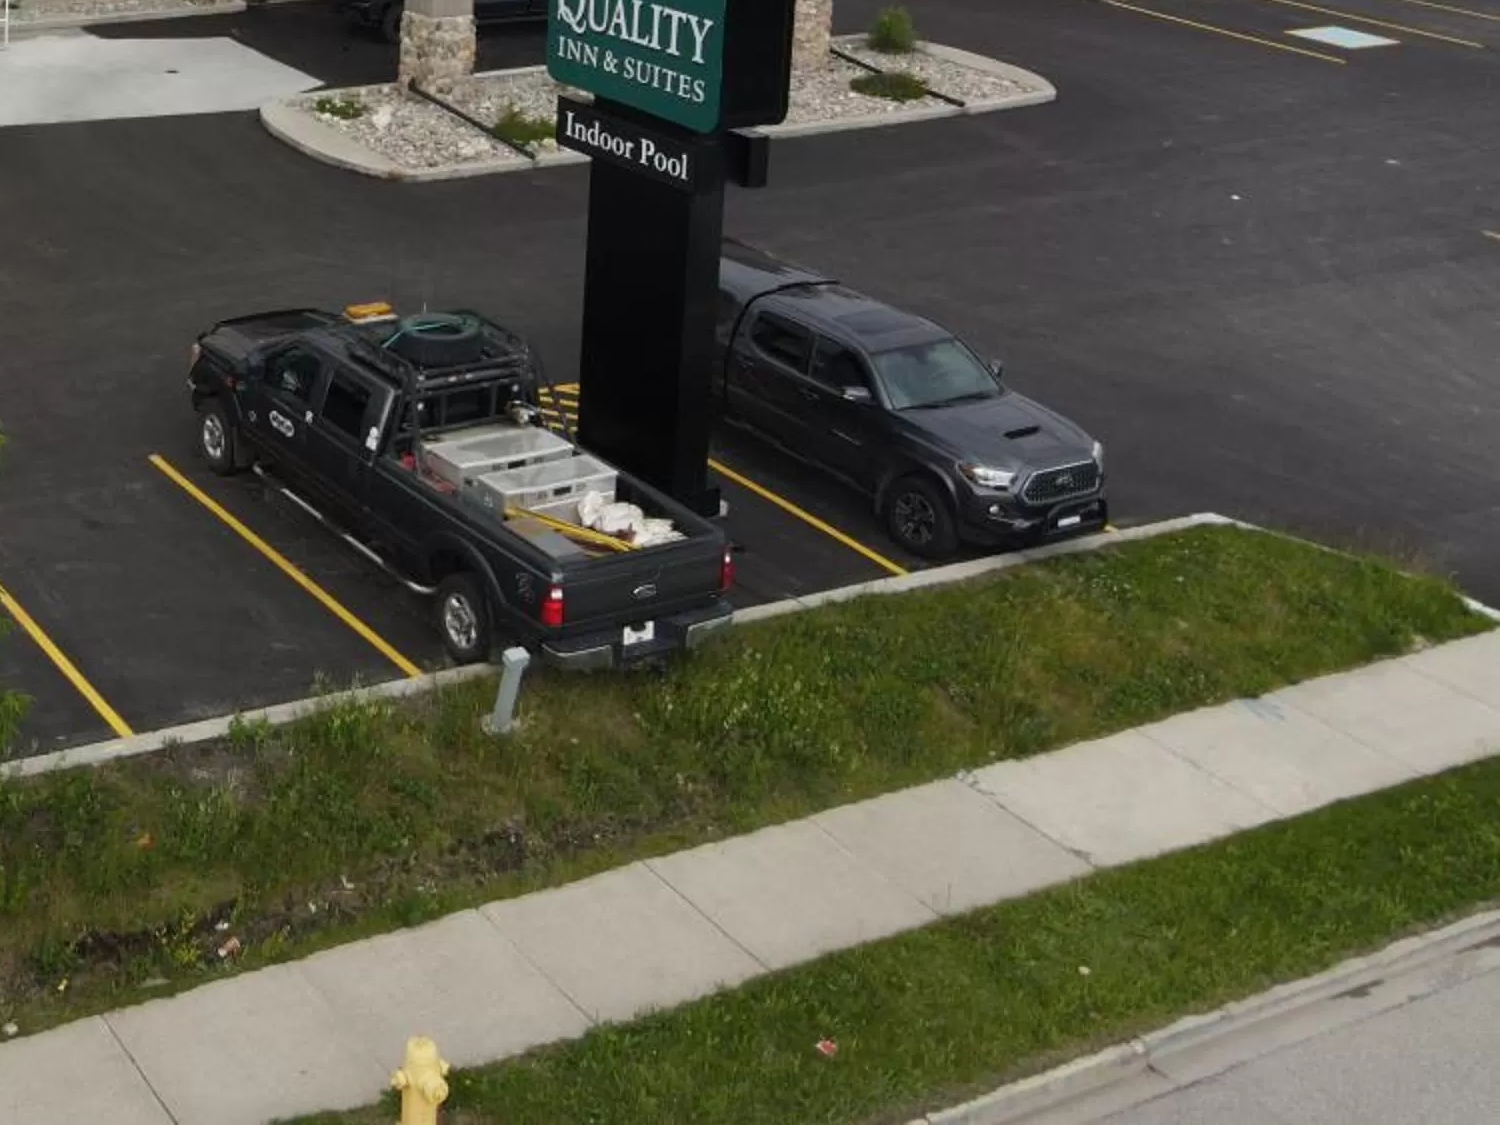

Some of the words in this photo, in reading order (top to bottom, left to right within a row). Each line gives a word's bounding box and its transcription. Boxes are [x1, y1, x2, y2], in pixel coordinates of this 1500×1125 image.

[557, 35, 599, 68] INN
[603, 50, 619, 74] &
[623, 56, 706, 103] SUITES
[565, 110, 635, 160] Indoor
[639, 137, 689, 181] Pool
